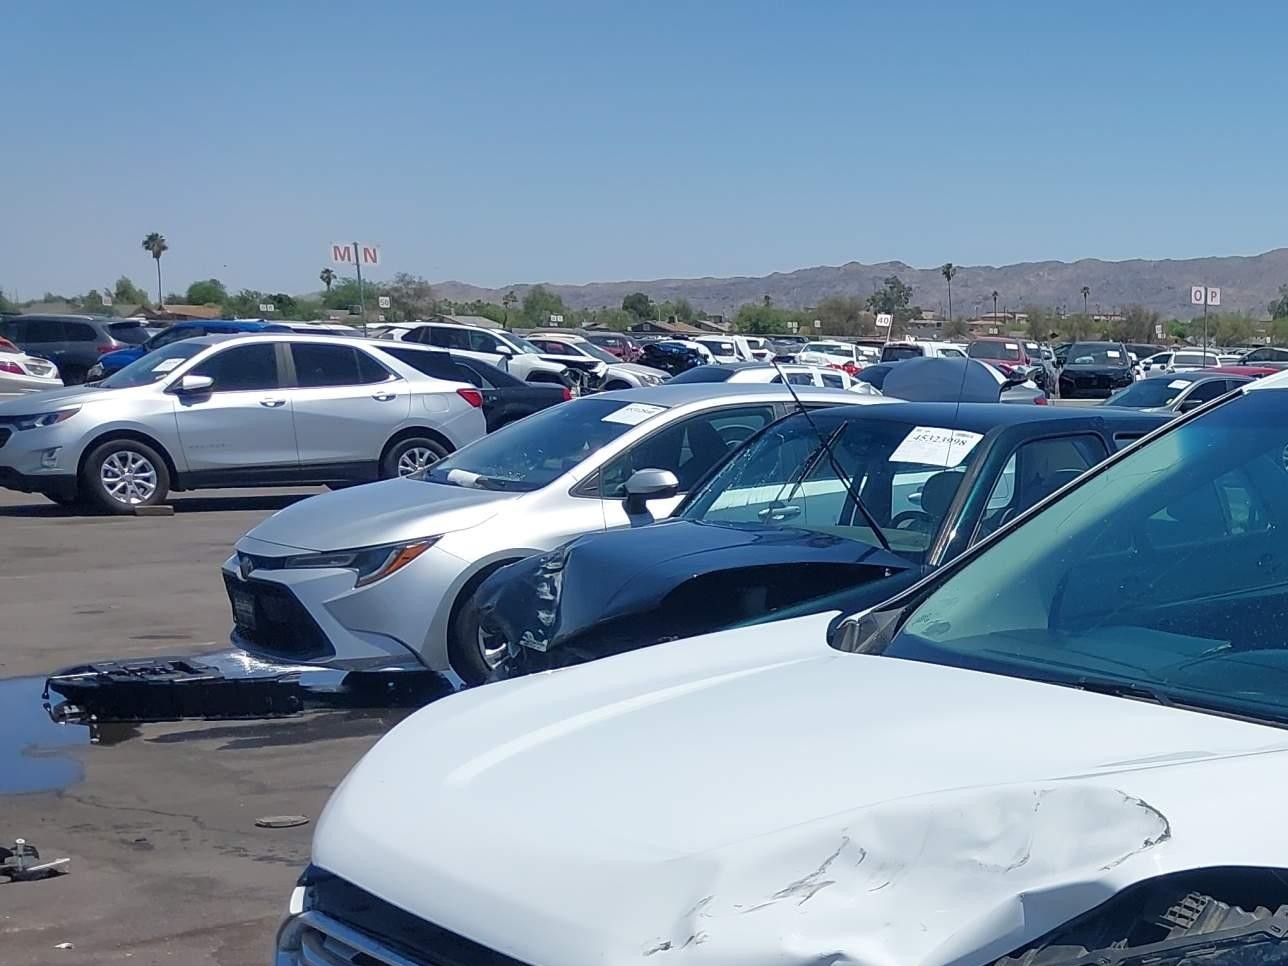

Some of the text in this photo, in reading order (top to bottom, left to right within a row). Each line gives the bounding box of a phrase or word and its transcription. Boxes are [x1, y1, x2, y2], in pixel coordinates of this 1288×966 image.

[333, 245, 377, 264] M N
[1194, 289, 1217, 303] O P
[380, 298, 389, 307] 50
[878, 316, 889, 325] 40
